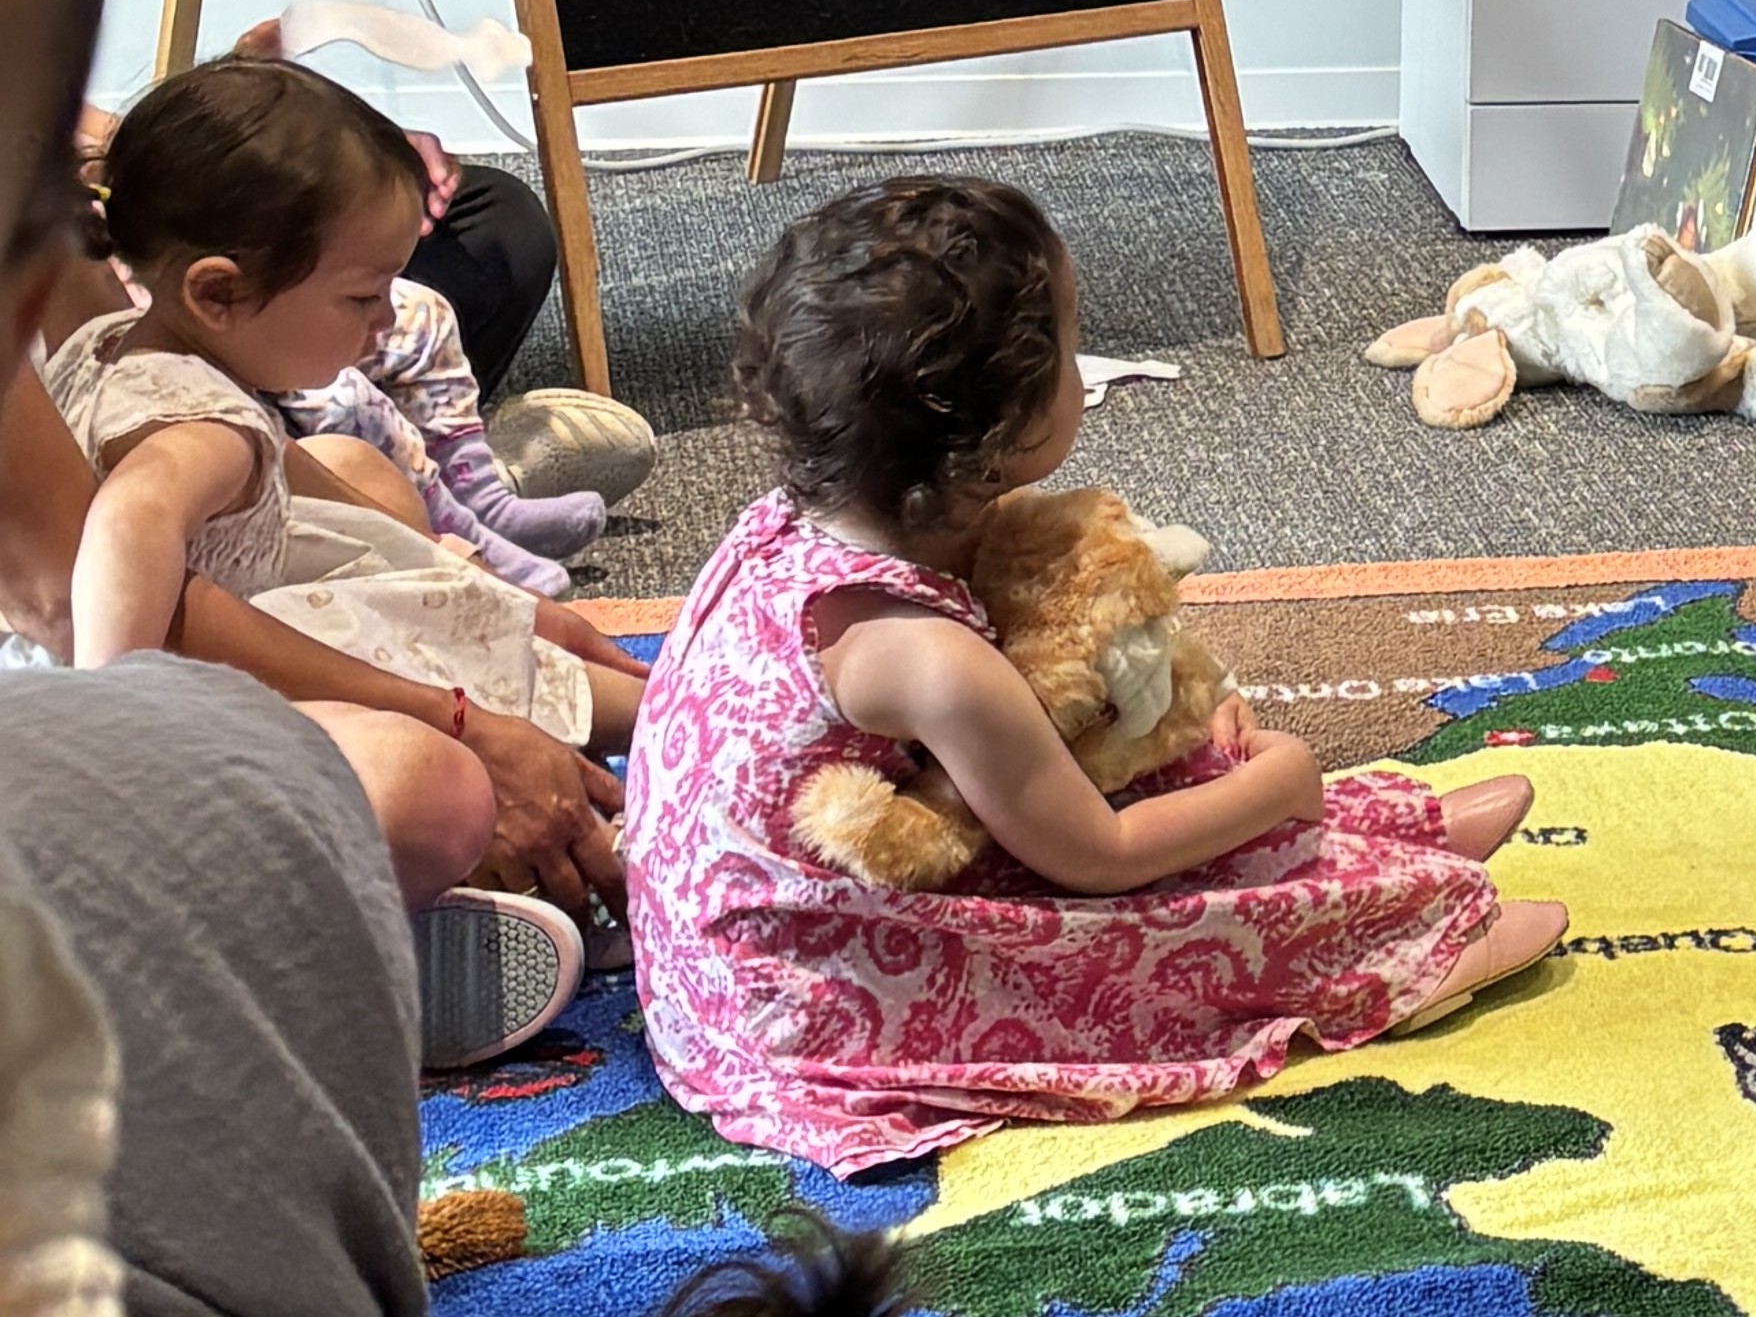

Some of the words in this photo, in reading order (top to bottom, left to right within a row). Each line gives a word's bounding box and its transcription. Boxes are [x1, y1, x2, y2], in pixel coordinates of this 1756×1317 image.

[1408, 604, 1520, 626] Erie
[1534, 595, 1669, 620] Lake
[1393, 671, 1538, 694] Lake
[1011, 1171, 1436, 1226] Labrador
